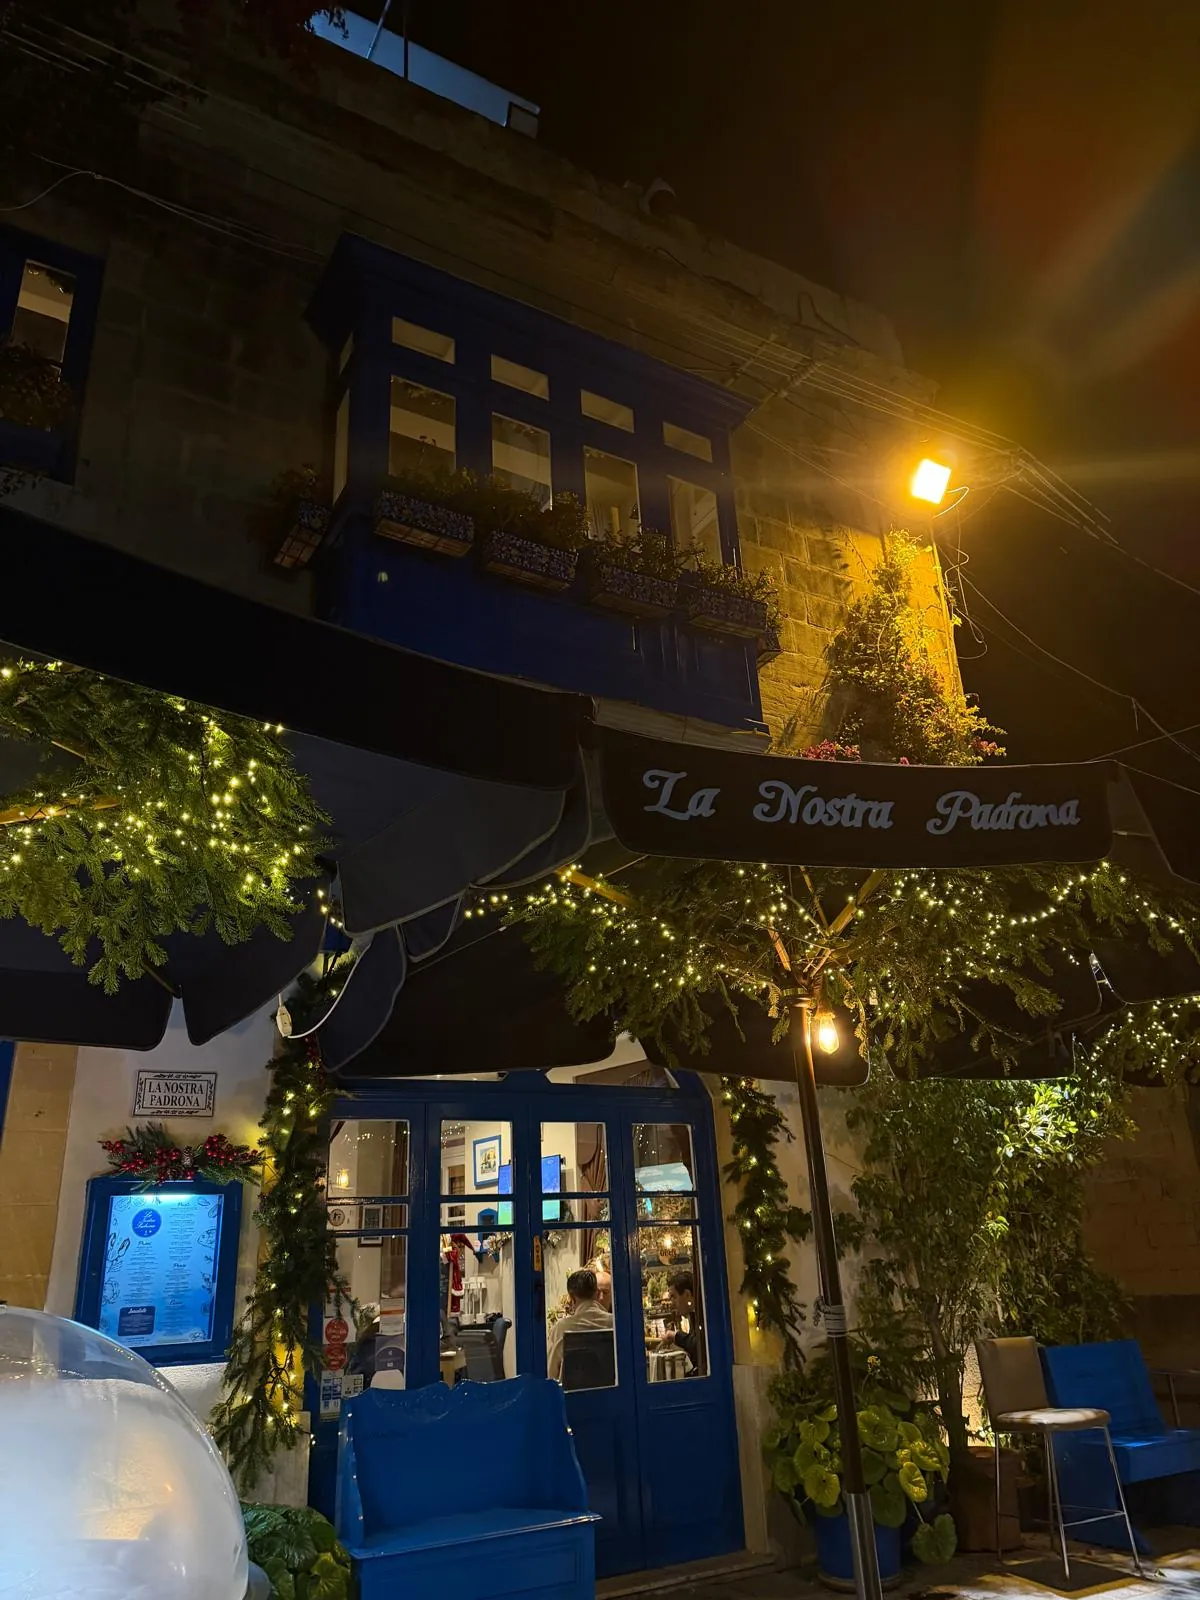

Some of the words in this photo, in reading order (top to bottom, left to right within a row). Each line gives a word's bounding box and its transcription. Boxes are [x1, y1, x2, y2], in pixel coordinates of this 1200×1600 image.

[643, 769, 721, 821] La
[752, 780, 895, 829] Nostra
[926, 790, 1080, 835] Padrona
[148, 1081, 161, 1093] LA
[162, 1082, 204, 1094] NOSTRA
[149, 1094, 200, 1107] PADRONA
